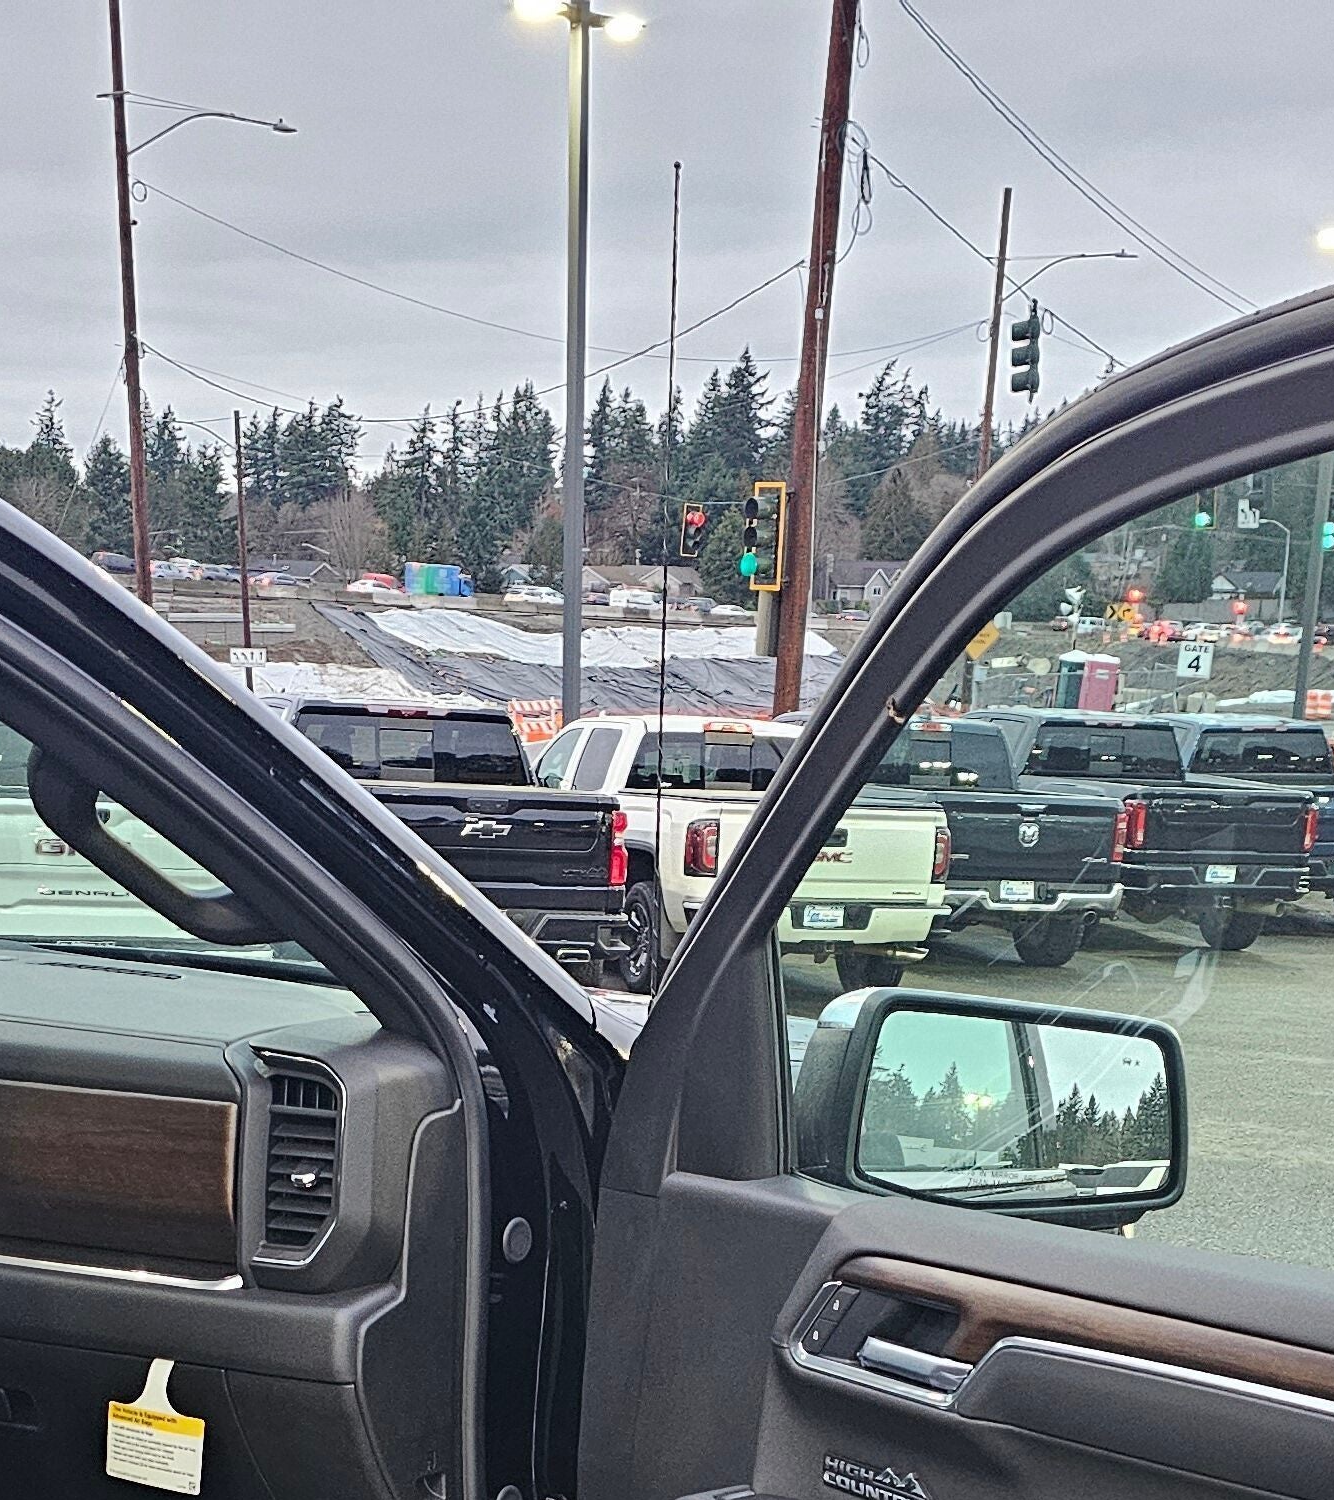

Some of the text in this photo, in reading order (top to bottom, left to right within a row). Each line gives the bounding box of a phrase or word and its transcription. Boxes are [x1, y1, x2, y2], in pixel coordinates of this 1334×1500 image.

[1184, 645, 1210, 653] GATE
[1187, 655, 1201, 672] 4
[825, 1456, 874, 1480] HIGH
